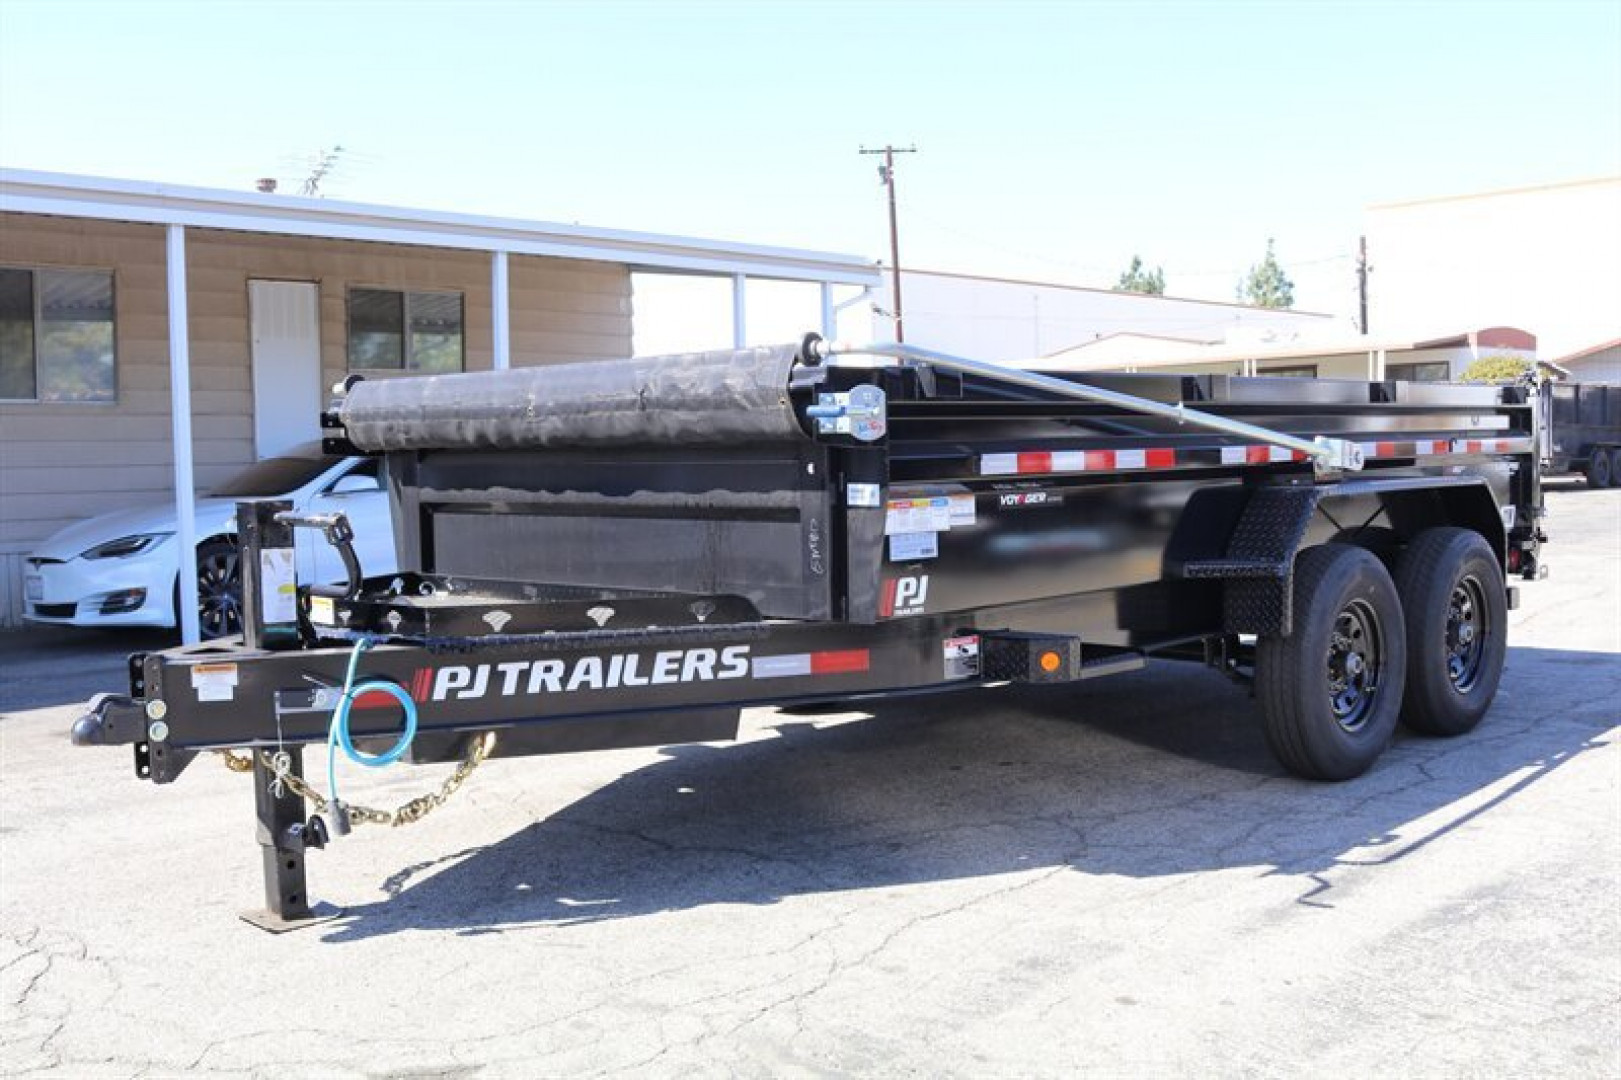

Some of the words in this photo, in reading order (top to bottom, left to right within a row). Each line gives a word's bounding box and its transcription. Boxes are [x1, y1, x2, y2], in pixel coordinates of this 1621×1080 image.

[895, 574, 929, 607] PJ
[432, 664, 492, 701] PJ
[498, 645, 751, 697] TRAILERS
